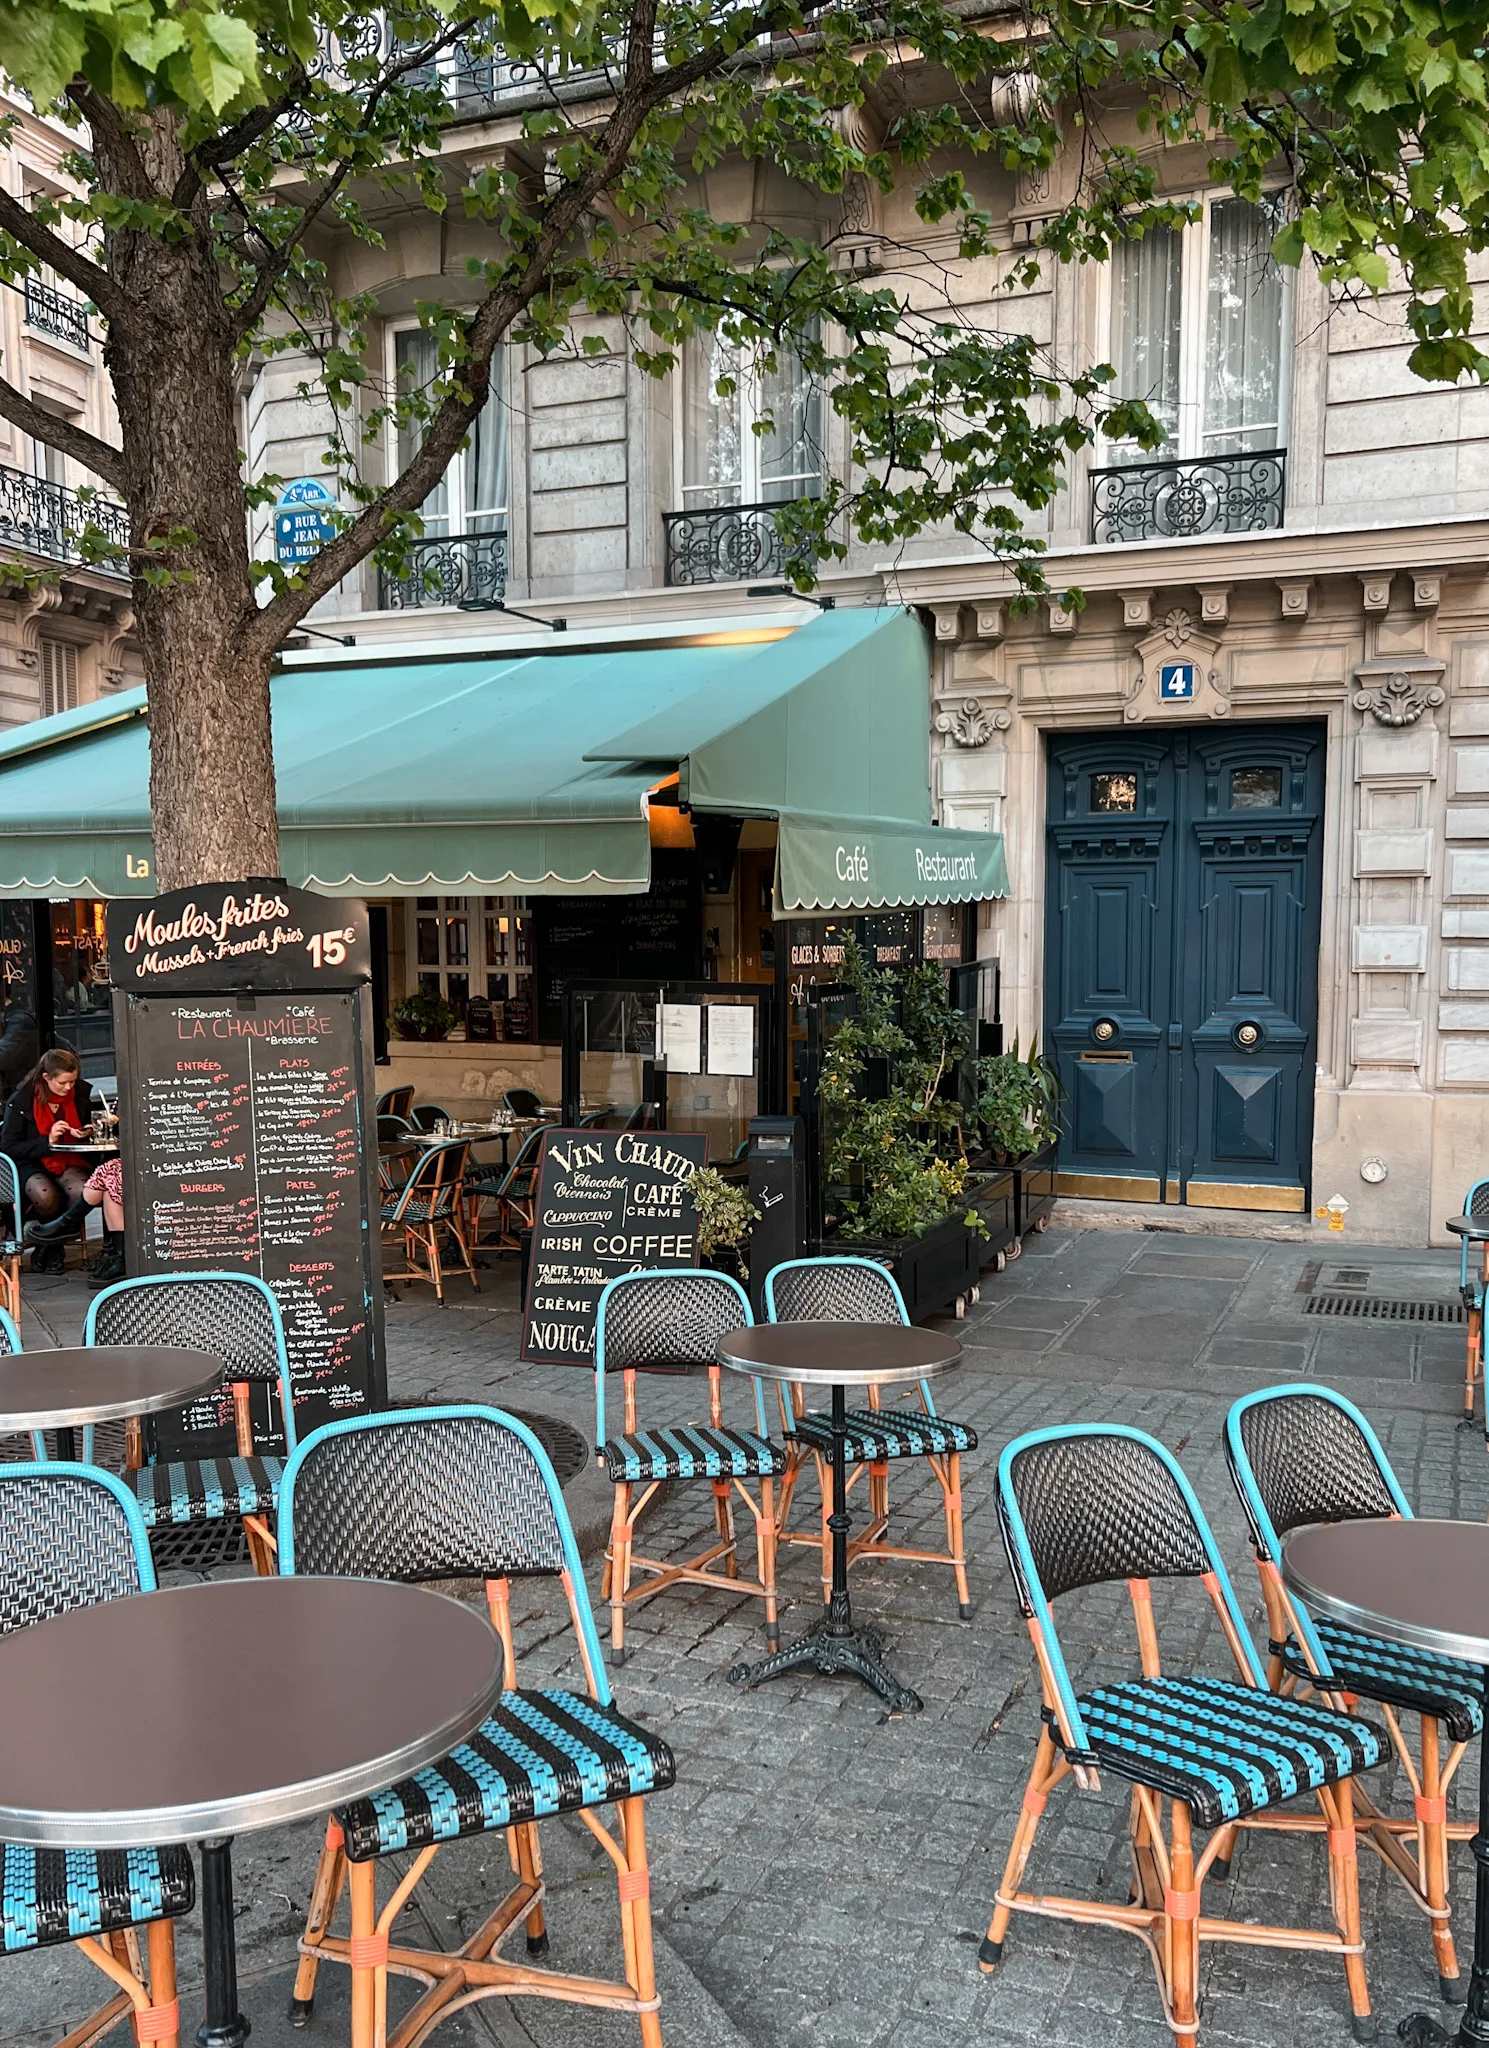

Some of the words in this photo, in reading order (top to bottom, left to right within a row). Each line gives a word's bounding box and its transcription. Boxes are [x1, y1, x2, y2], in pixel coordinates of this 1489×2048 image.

[294, 514, 317, 528] RUE
[293, 528, 320, 543] JEAN
[280, 546, 292, 558] DU
[1168, 668, 1186, 694] 4
[126, 854, 149, 878] La
[835, 846, 868, 882] Café
[915, 848, 978, 882] Restaurant
[124, 902, 217, 954] Moules
[212, 893, 290, 942] frites
[266, 926, 305, 954] fries
[792, 945, 813, 965] GLACES
[876, 946, 901, 962] BREAKFAST
[178, 1008, 232, 1018] Restaurant
[292, 1006, 315, 1018] Café
[178, 1020, 206, 1039] LA
[270, 1036, 318, 1045] Brasserie
[176, 1058, 222, 1070] ENTRÉES
[280, 1059, 310, 1068] PLATS
[286, 1181, 316, 1190] PATES
[573, 1171, 629, 1188] Chocolat
[180, 1184, 226, 1193] BURGERS
[554, 1182, 612, 1200] Viennois
[634, 1182, 684, 1206] CAFÉ
[626, 1206, 682, 1218] CRÈME
[541, 1237, 582, 1252] IRISH
[594, 1234, 693, 1258] COFFEE
[289, 1262, 335, 1272] DESSERTS
[538, 1264, 570, 1276] TARTE
[572, 1266, 603, 1278] TATIN
[534, 1296, 592, 1312] CRÈME
